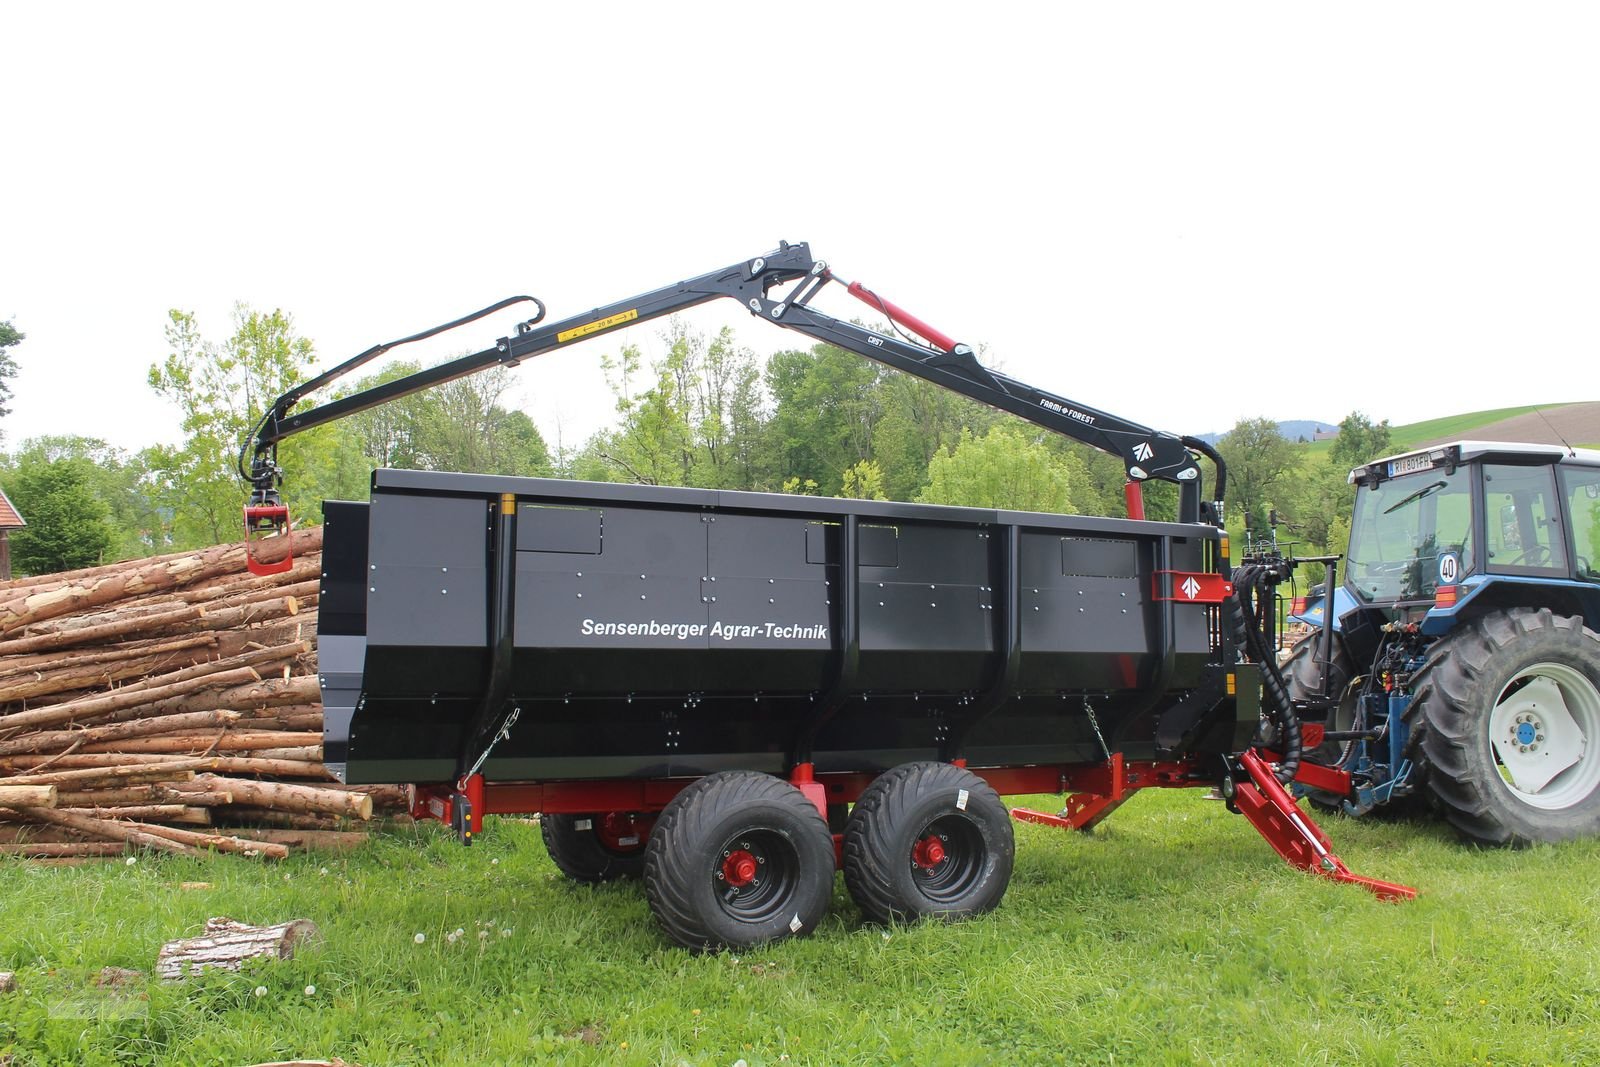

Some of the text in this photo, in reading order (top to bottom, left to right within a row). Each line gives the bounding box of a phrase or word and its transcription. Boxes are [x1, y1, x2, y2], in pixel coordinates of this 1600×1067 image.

[1039, 398, 1096, 425] FARMI FOREST
[1442, 558, 1454, 578] 40
[581, 618, 828, 641] Sensenberger Agrar-Technik
